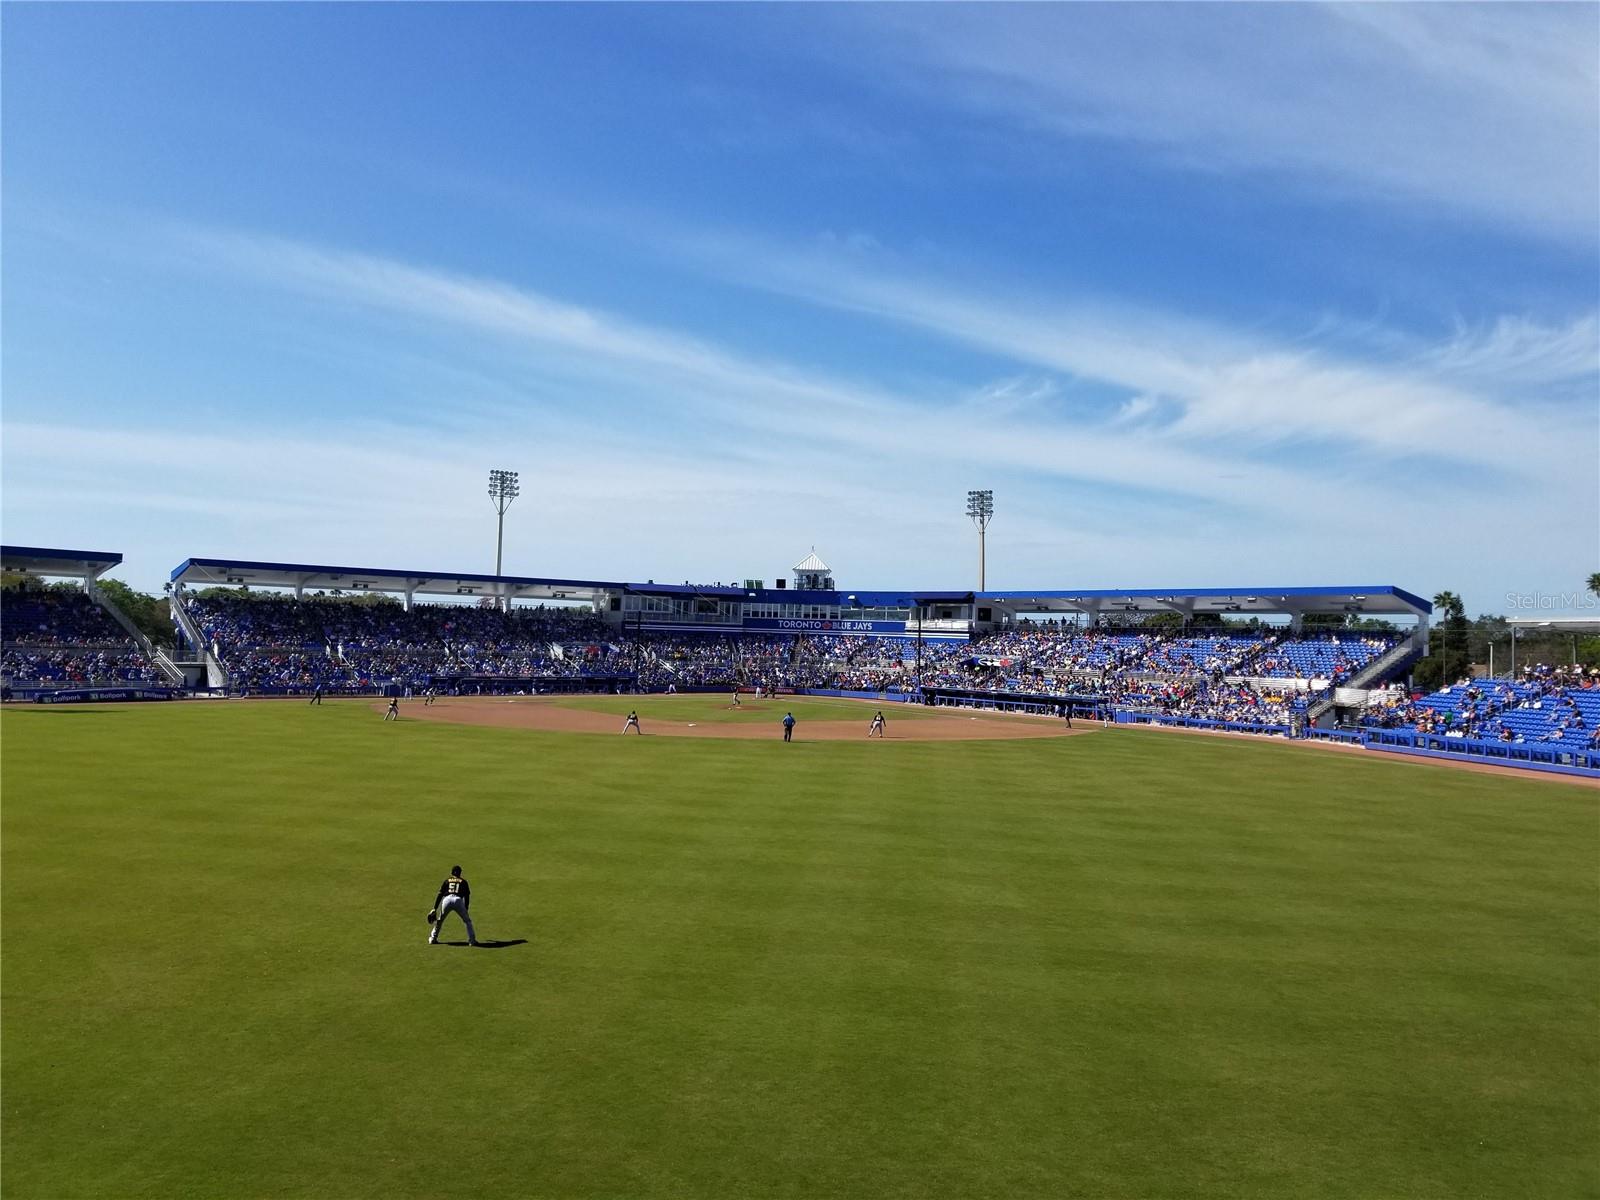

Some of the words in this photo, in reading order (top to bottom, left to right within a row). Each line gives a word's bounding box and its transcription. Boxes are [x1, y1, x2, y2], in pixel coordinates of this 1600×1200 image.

[778, 620, 822, 629] TORONTO
[832, 621, 851, 630] BLUE
[852, 622, 873, 631] JAYS
[53, 694, 81, 703] Ballpark
[100, 692, 127, 700] Ballpark
[143, 691, 167, 699] Ballpark
[448, 882, 460, 894] 51
